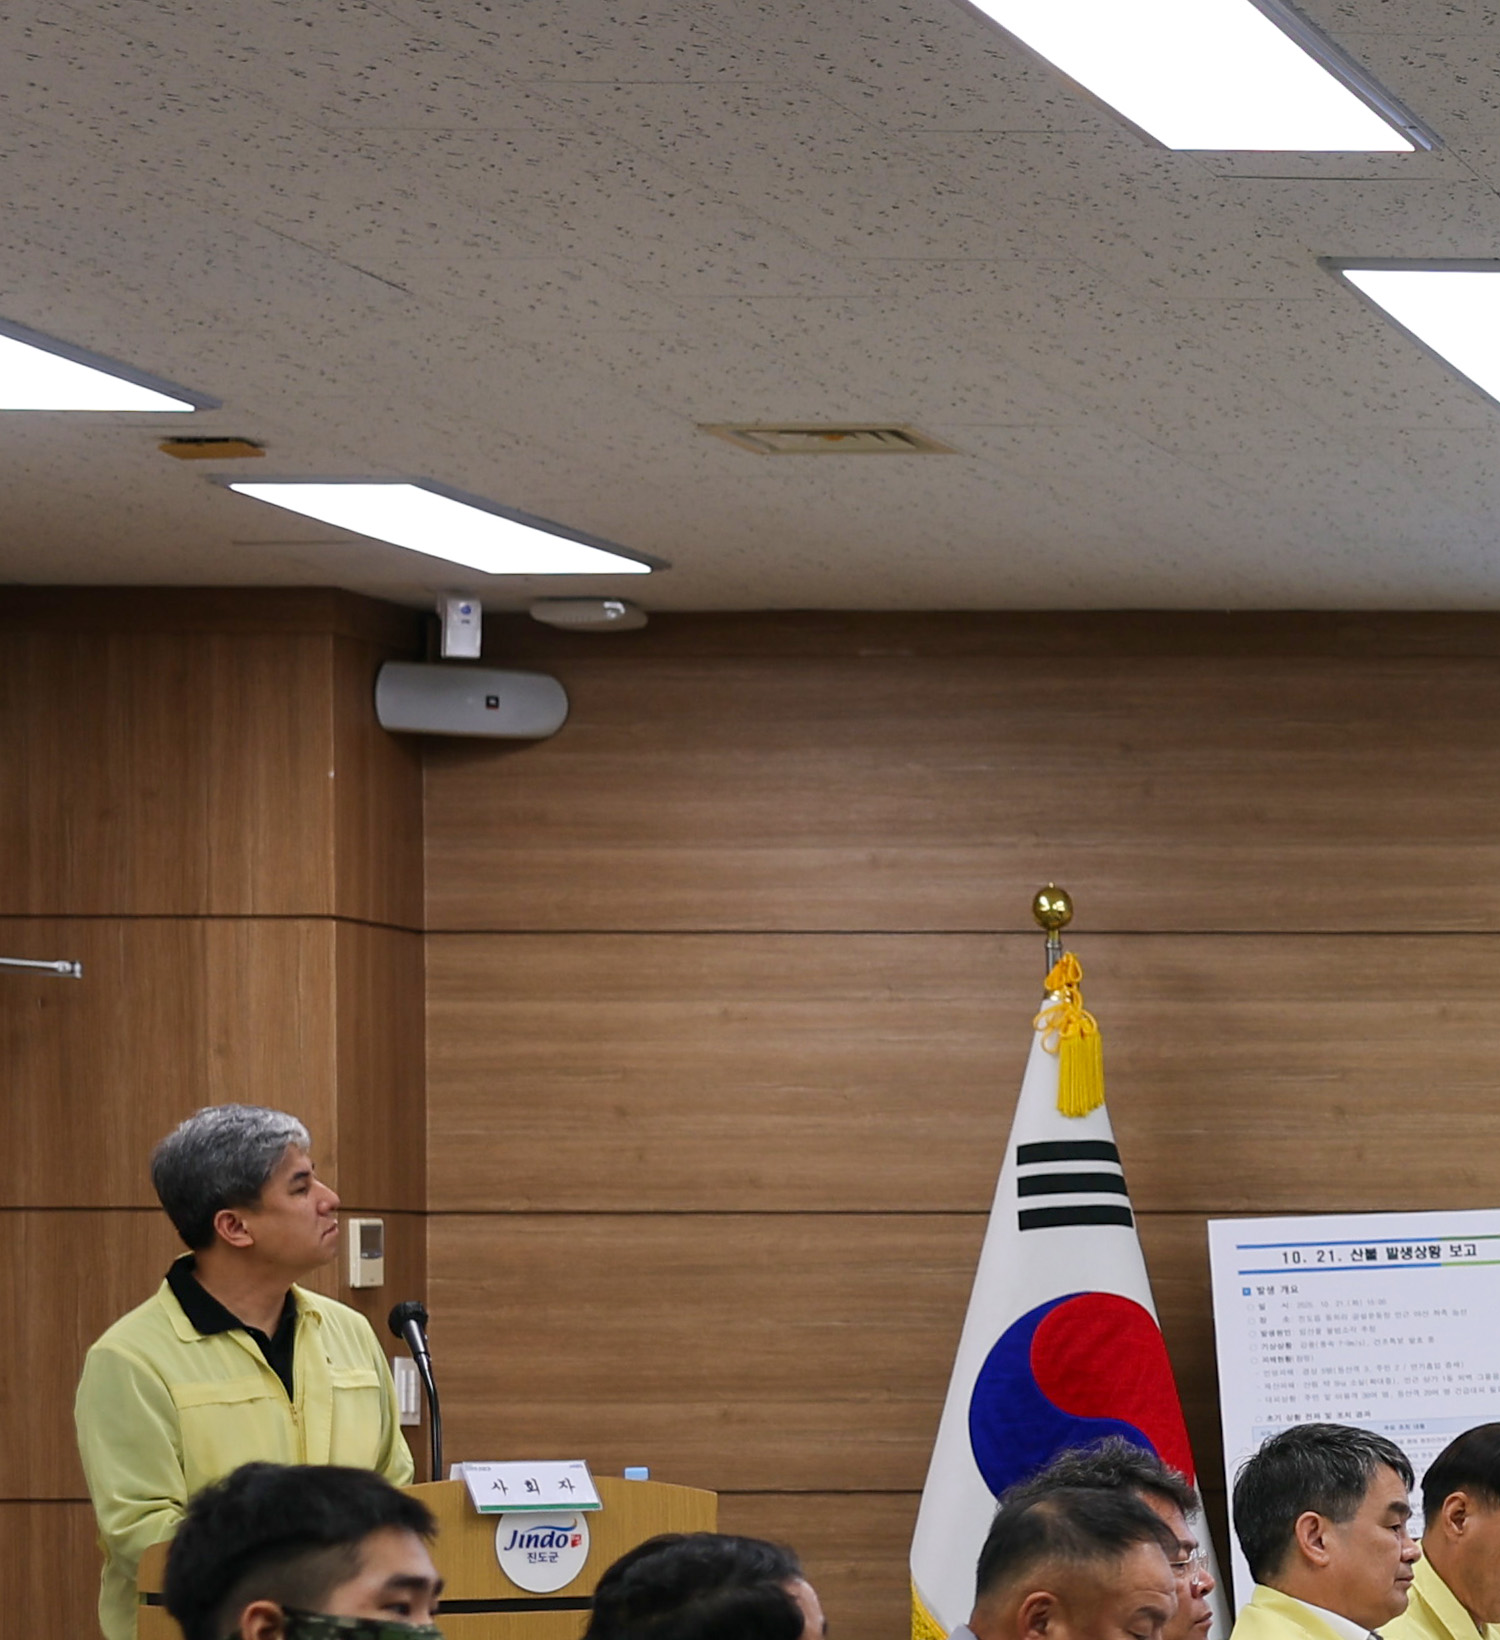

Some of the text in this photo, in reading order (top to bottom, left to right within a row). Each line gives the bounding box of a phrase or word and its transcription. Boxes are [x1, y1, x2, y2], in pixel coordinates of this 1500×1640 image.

[1282, 1243, 1478, 1264] 10. 21. 산불 발생상황 보고
[503, 1529, 569, 1551] Jindo
[526, 1551, 559, 1564] 진도군
